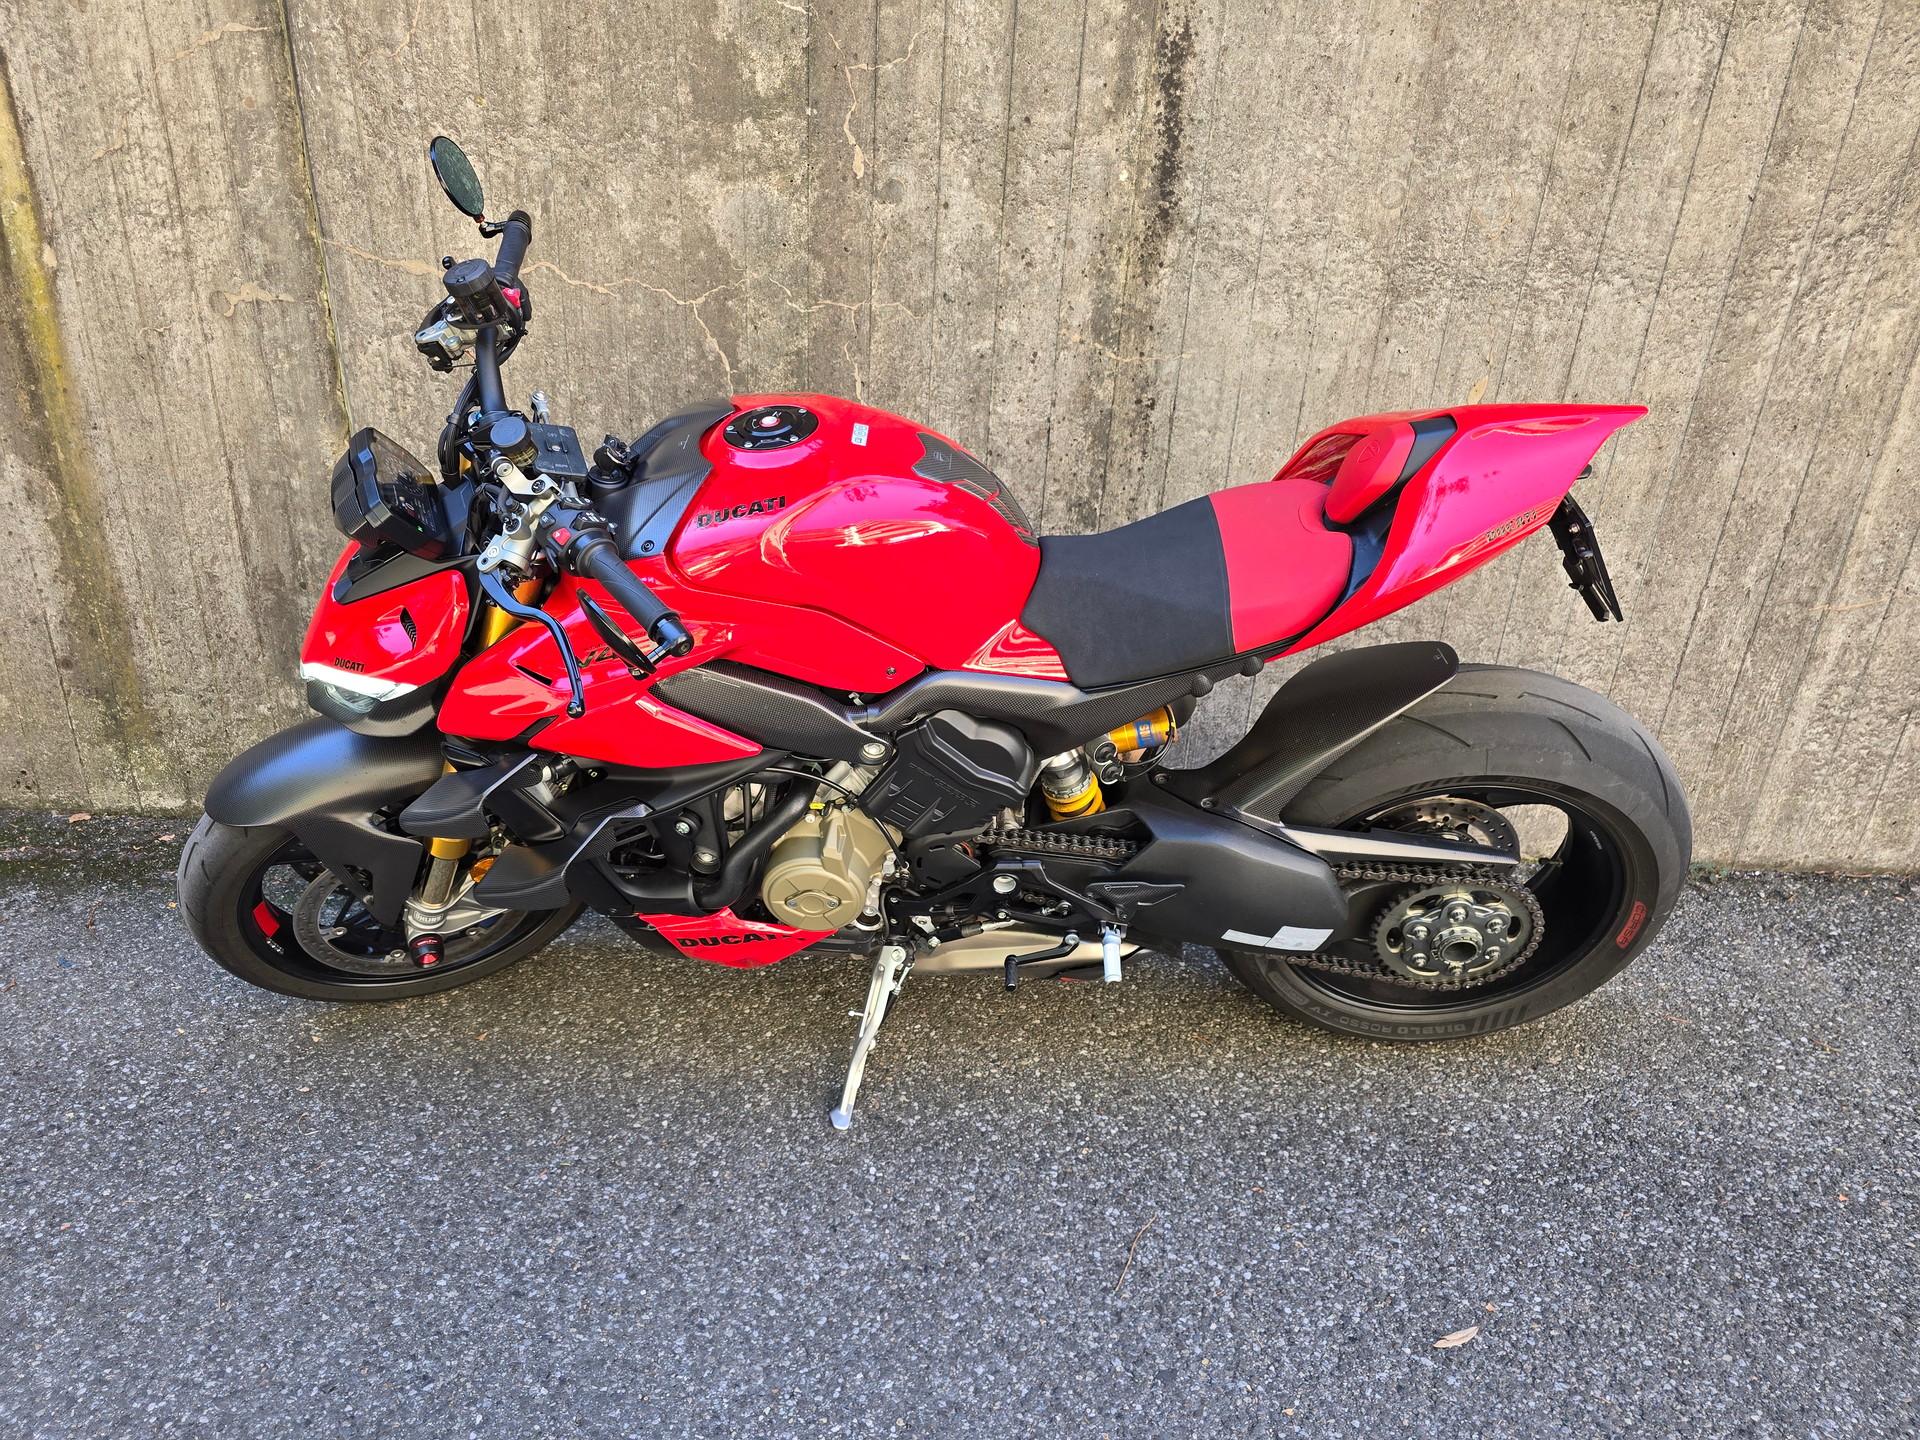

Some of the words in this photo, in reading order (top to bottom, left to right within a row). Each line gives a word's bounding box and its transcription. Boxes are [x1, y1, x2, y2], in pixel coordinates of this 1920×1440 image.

[697, 496, 786, 528] DUCATI
[1485, 509, 1537, 542] DUCATI
[334, 657, 365, 672] DUCATI
[676, 933, 806, 947] DUCA
[1339, 1015, 1392, 1033] ROSSO
[1397, 1022, 1468, 1035] DIABLO
